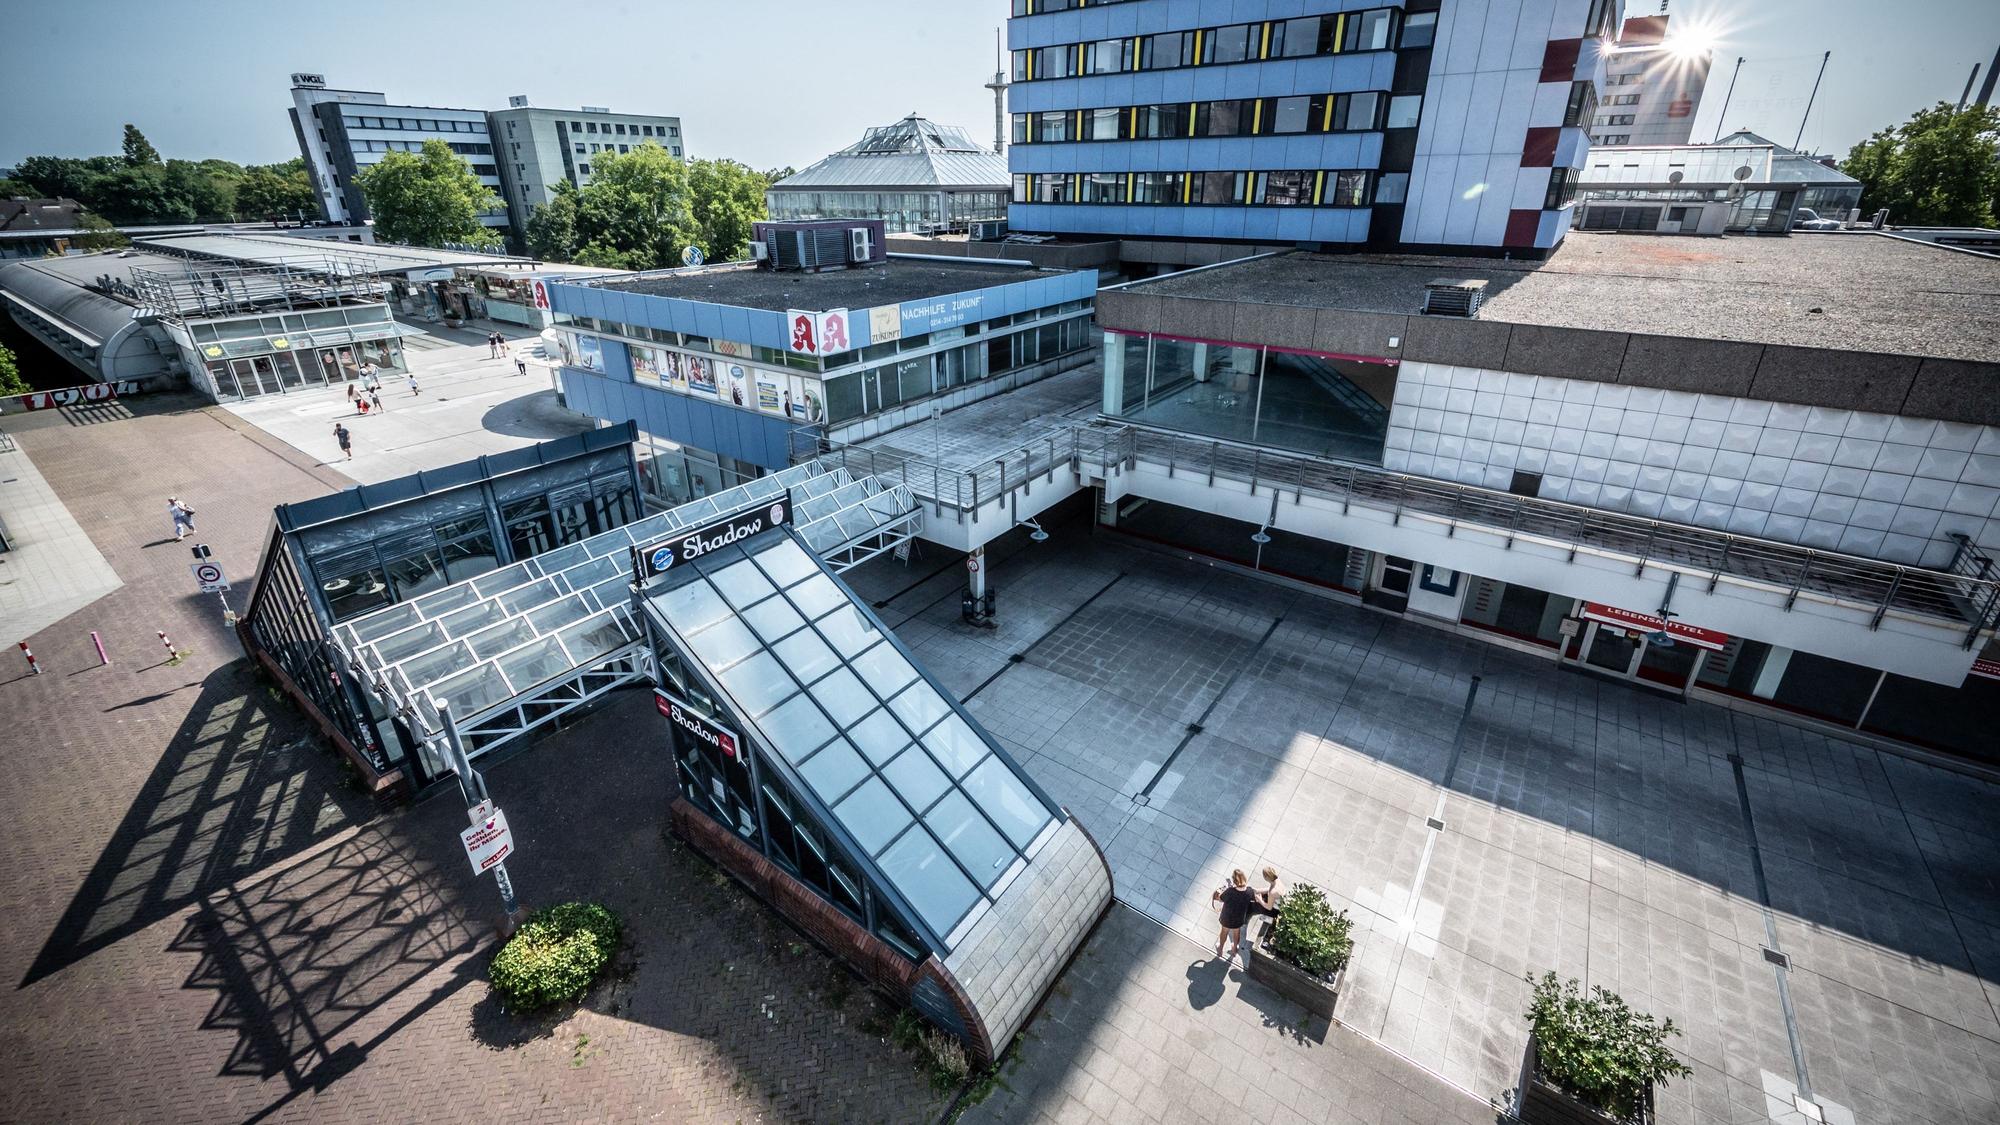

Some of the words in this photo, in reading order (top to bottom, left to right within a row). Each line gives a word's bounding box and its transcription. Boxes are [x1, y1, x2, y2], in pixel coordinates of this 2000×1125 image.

[299, 74, 325, 84] WGL
[901, 303, 946, 321] NACHHILFE
[31, 381, 140, 409] 1904
[682, 518, 762, 560] Shadow
[671, 704, 720, 747] Shadow
[466, 829, 485, 842] Geht
